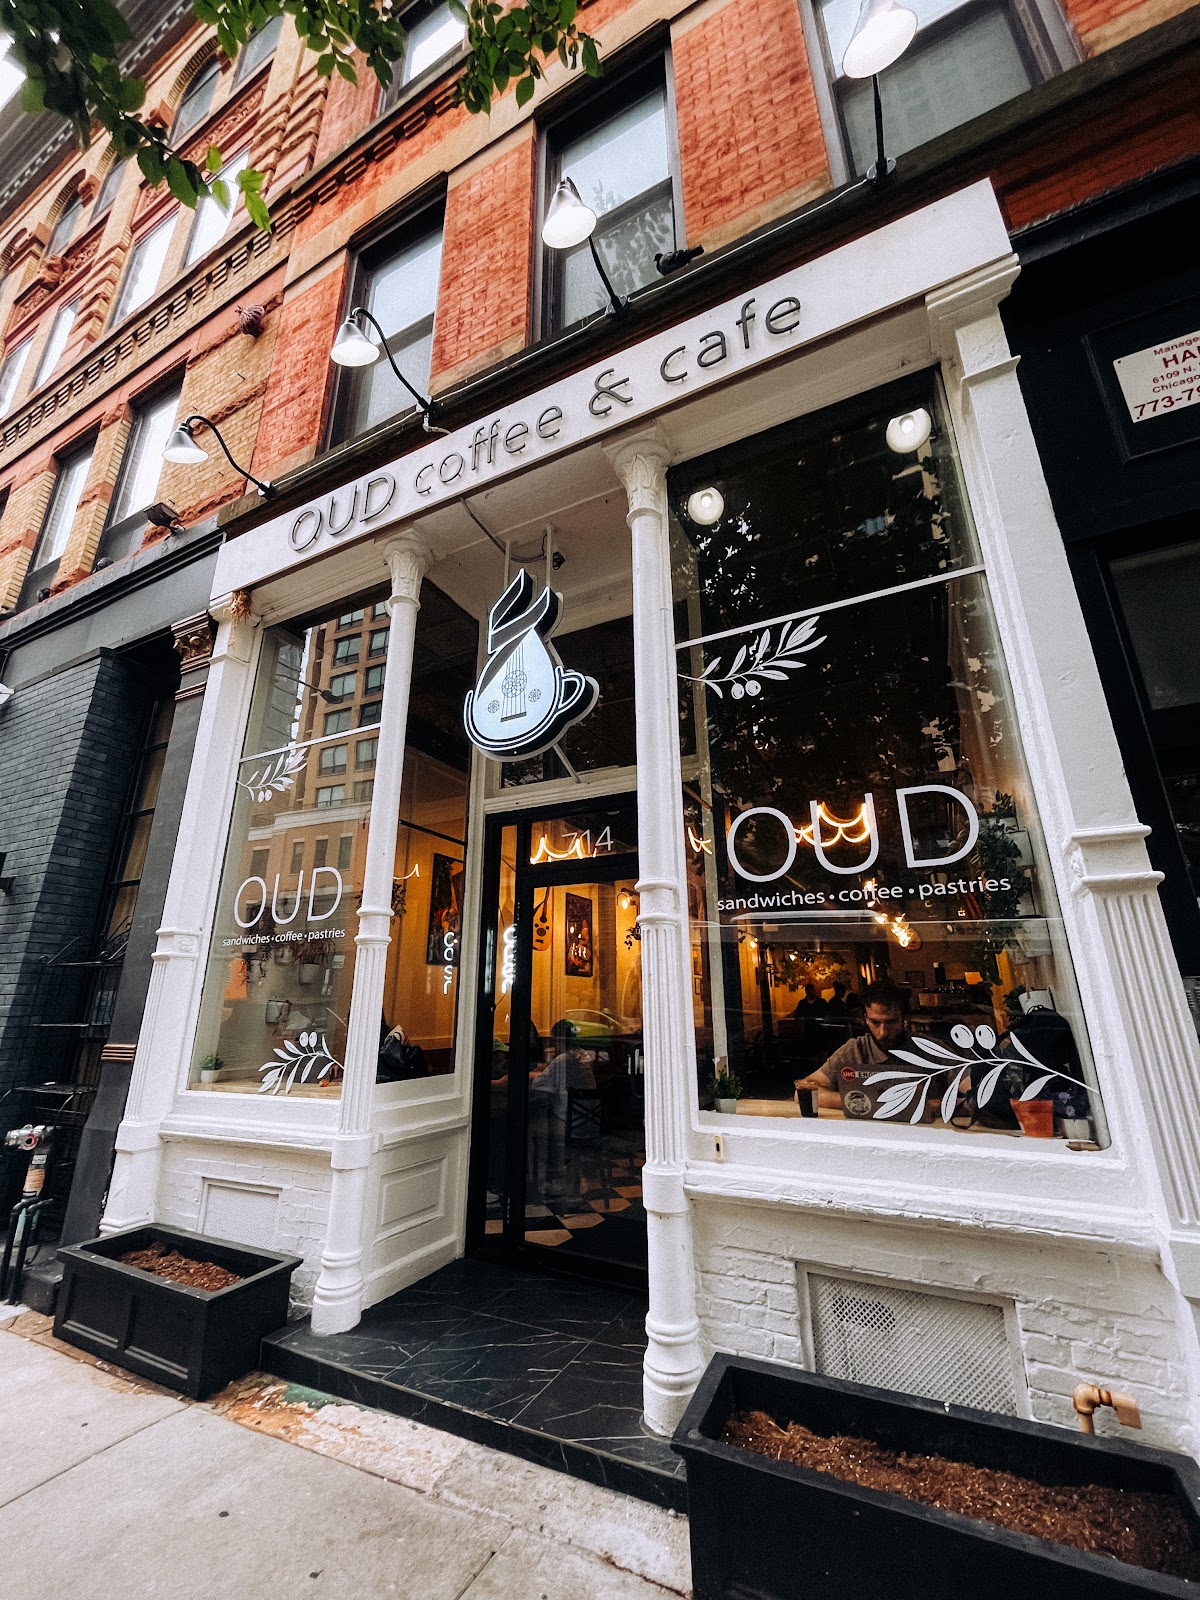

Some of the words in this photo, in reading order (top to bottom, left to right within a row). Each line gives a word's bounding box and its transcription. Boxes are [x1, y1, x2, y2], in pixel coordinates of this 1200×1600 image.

[1152, 370, 1180, 384] 6109
[287, 471, 396, 551] OUD
[414, 405, 563, 495] coffee
[589, 368, 634, 416] &
[660, 296, 801, 382] cafe
[561, 825, 614, 855] 714
[726, 784, 979, 882] OUD
[233, 866, 343, 928] OUD
[716, 888, 826, 911] sandwiches
[838, 882, 904, 902] coffee
[918, 876, 1012, 900] pastries
[222, 933, 270, 947] sandwiches
[274, 931, 303, 943] coffee
[307, 927, 346, 942] pastries
